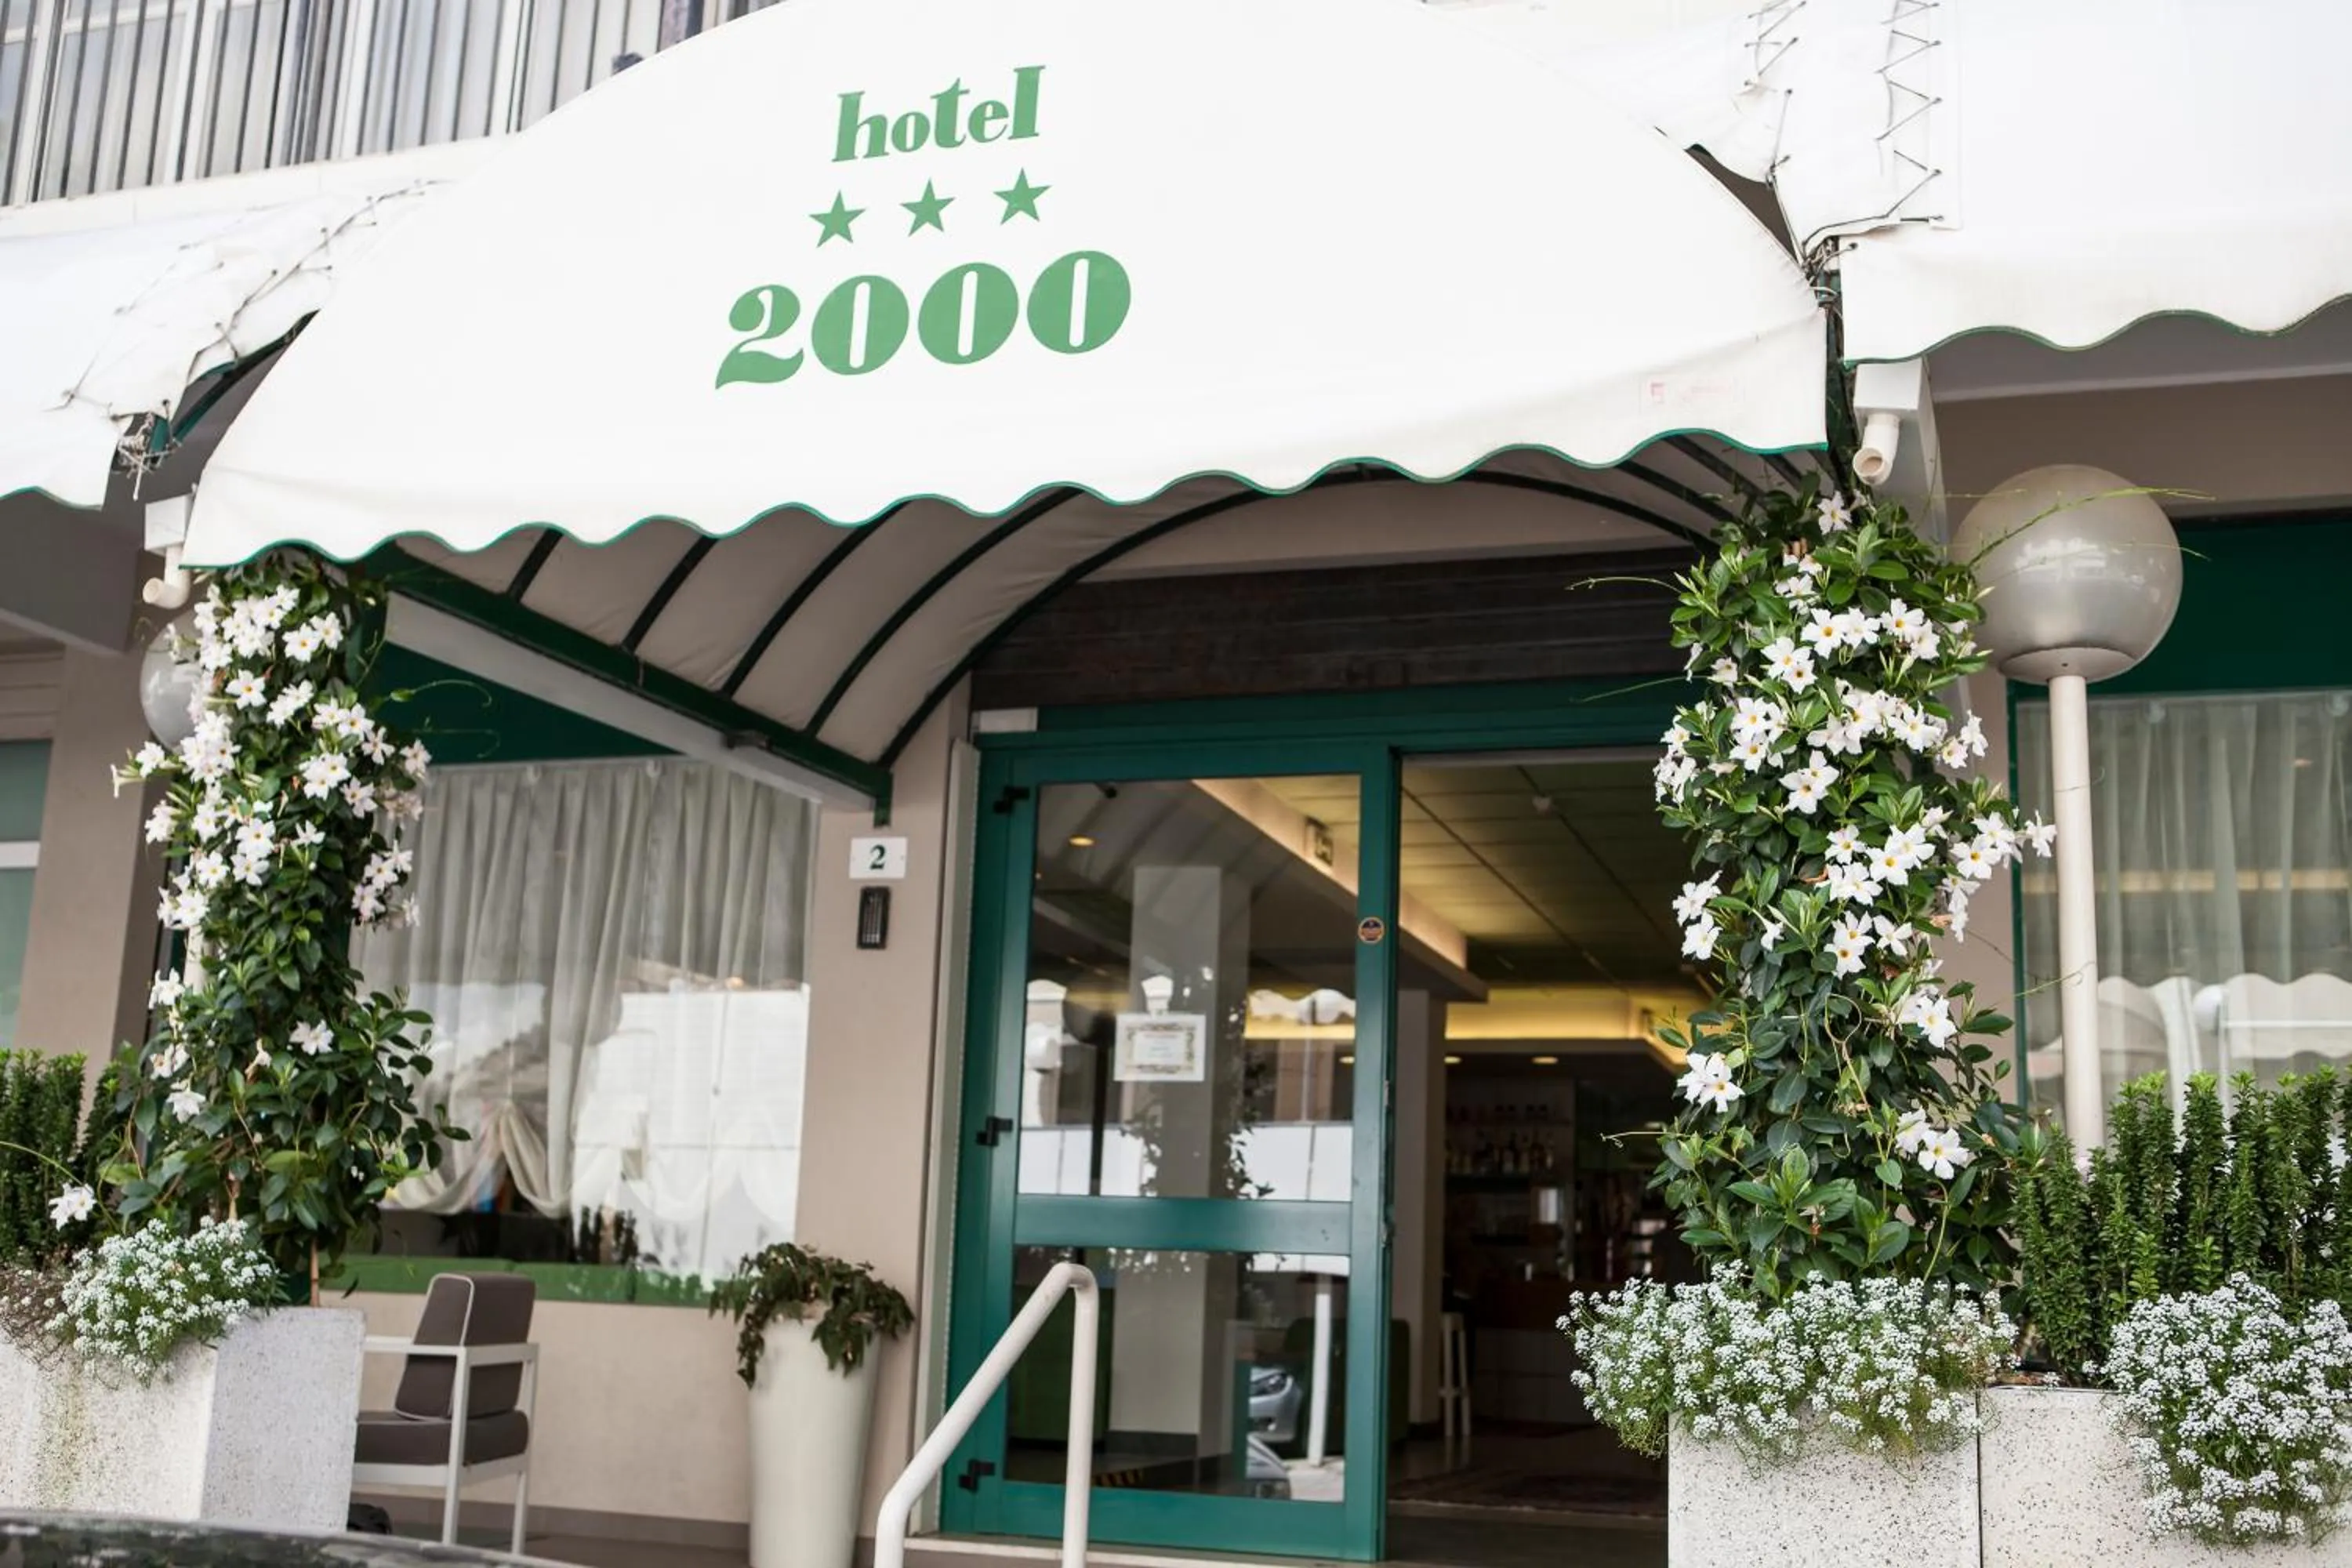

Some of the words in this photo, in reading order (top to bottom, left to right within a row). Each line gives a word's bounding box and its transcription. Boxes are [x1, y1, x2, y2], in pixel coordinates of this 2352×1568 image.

[832, 65, 1046, 162] hotel
[715, 250, 1131, 390] 2000
[869, 844, 886, 869] 2
